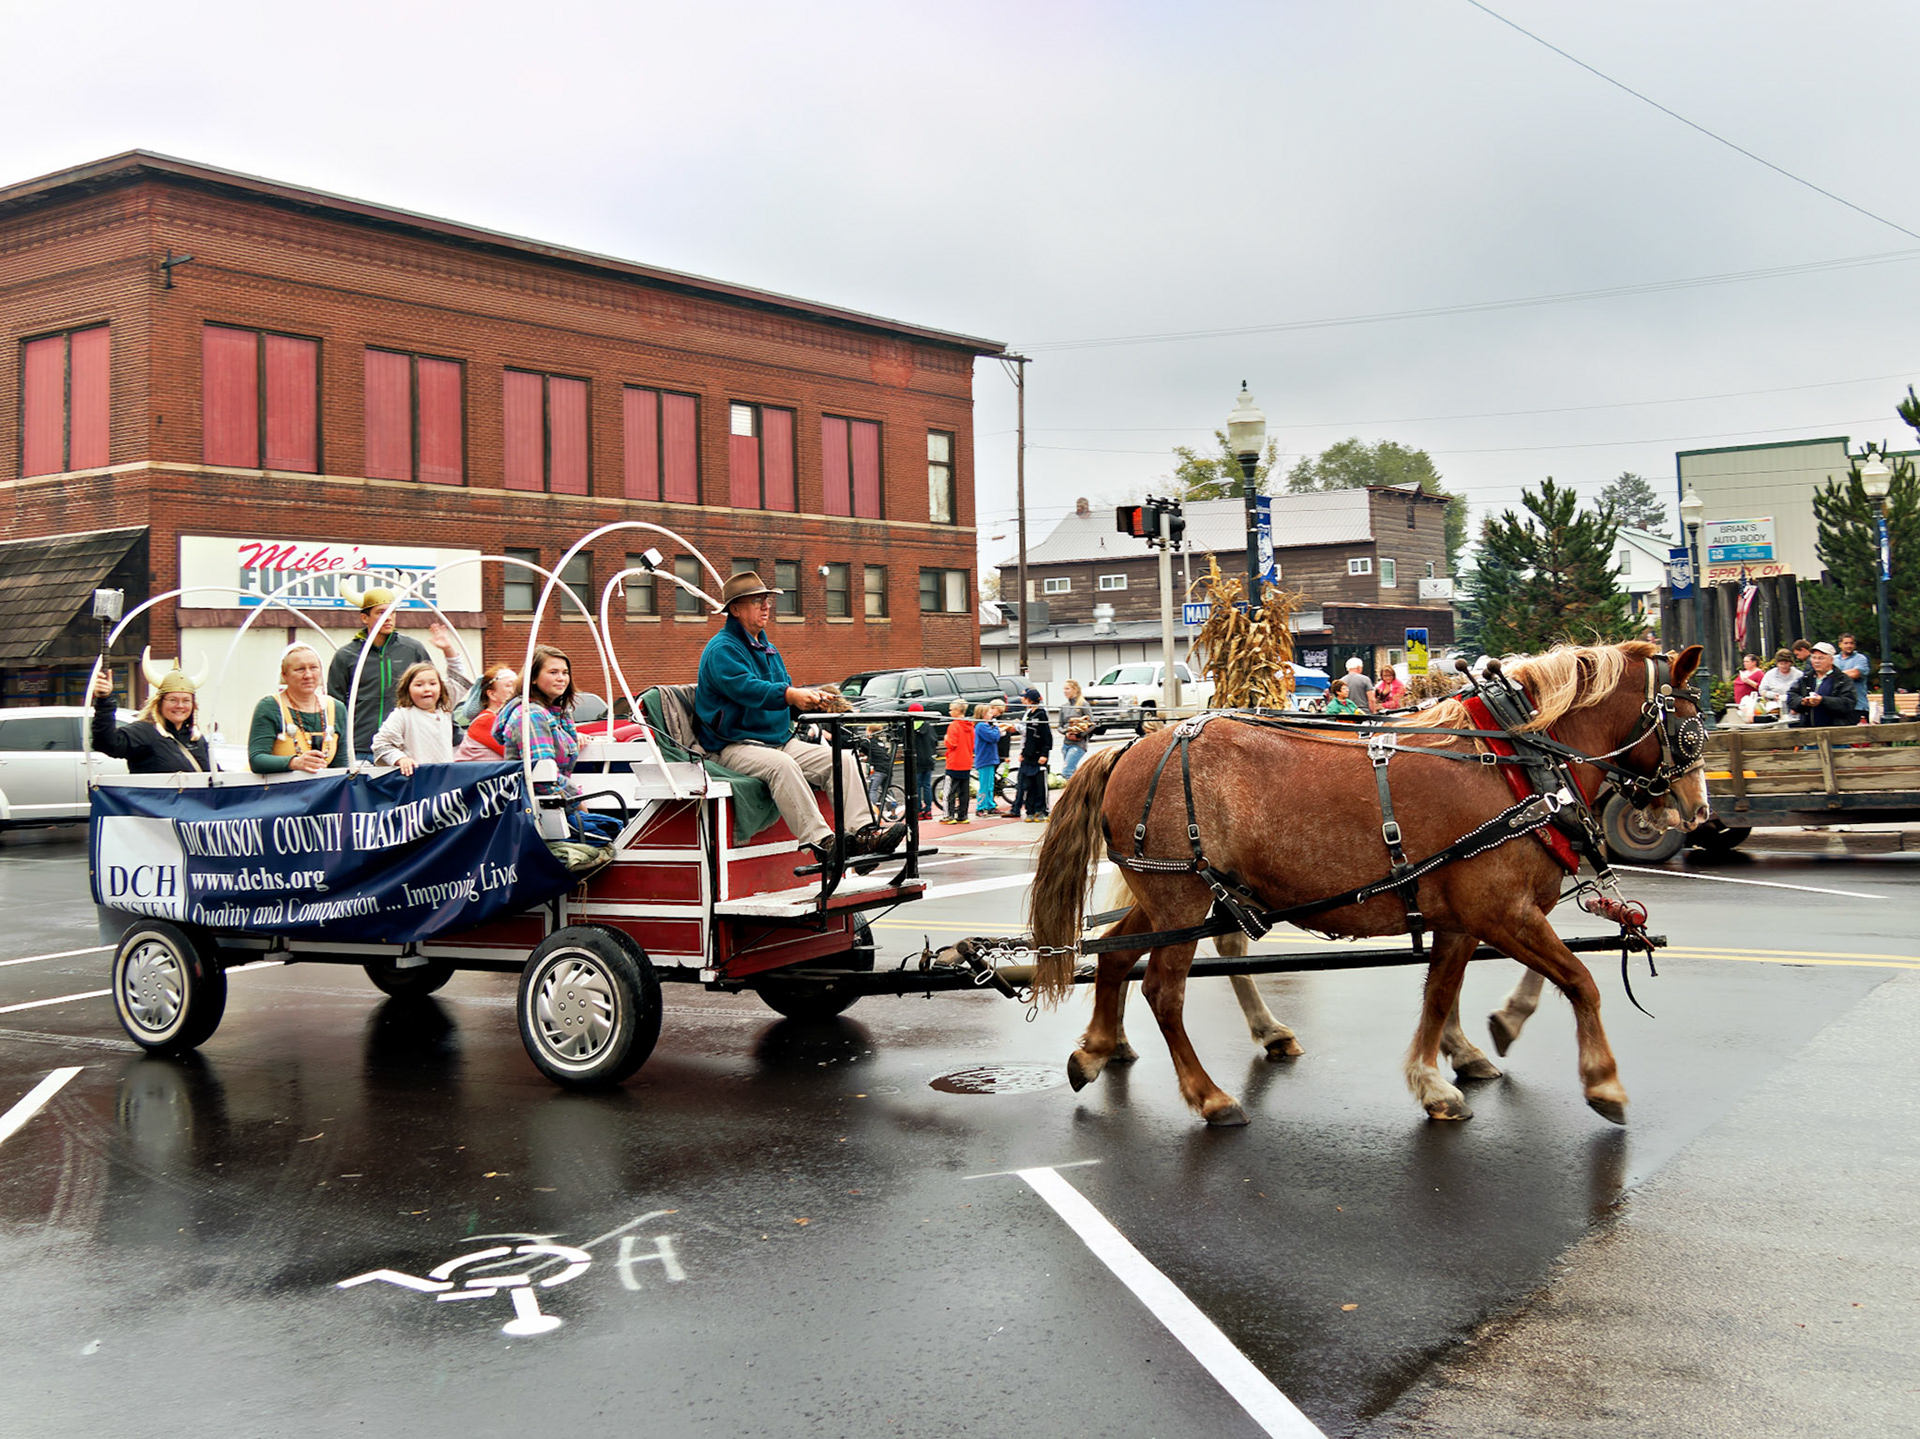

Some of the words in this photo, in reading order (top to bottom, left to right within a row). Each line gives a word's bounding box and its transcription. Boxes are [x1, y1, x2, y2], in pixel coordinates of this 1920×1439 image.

[1712, 535, 1737, 544] AUTO
[1740, 533, 1767, 543] BODY
[1720, 524, 1757, 533] BRIAN'S
[238, 542, 371, 572] Mike's
[1708, 566, 1756, 578] SPRY
[1762, 564, 1785, 576] ON
[239, 566, 437, 599] FURNTURE
[180, 818, 265, 857] DICKINSON
[273, 812, 344, 855] COUNTY
[351, 787, 472, 851] HEALTHCARE
[108, 865, 177, 898] DCH
[190, 867, 330, 892] www.dchs.org
[193, 901, 250, 931] Quality
[253, 899, 283, 925] and
[286, 891, 380, 928] Compassion
[401, 871, 480, 910] Improvig
[480, 861, 518, 892] Livs
